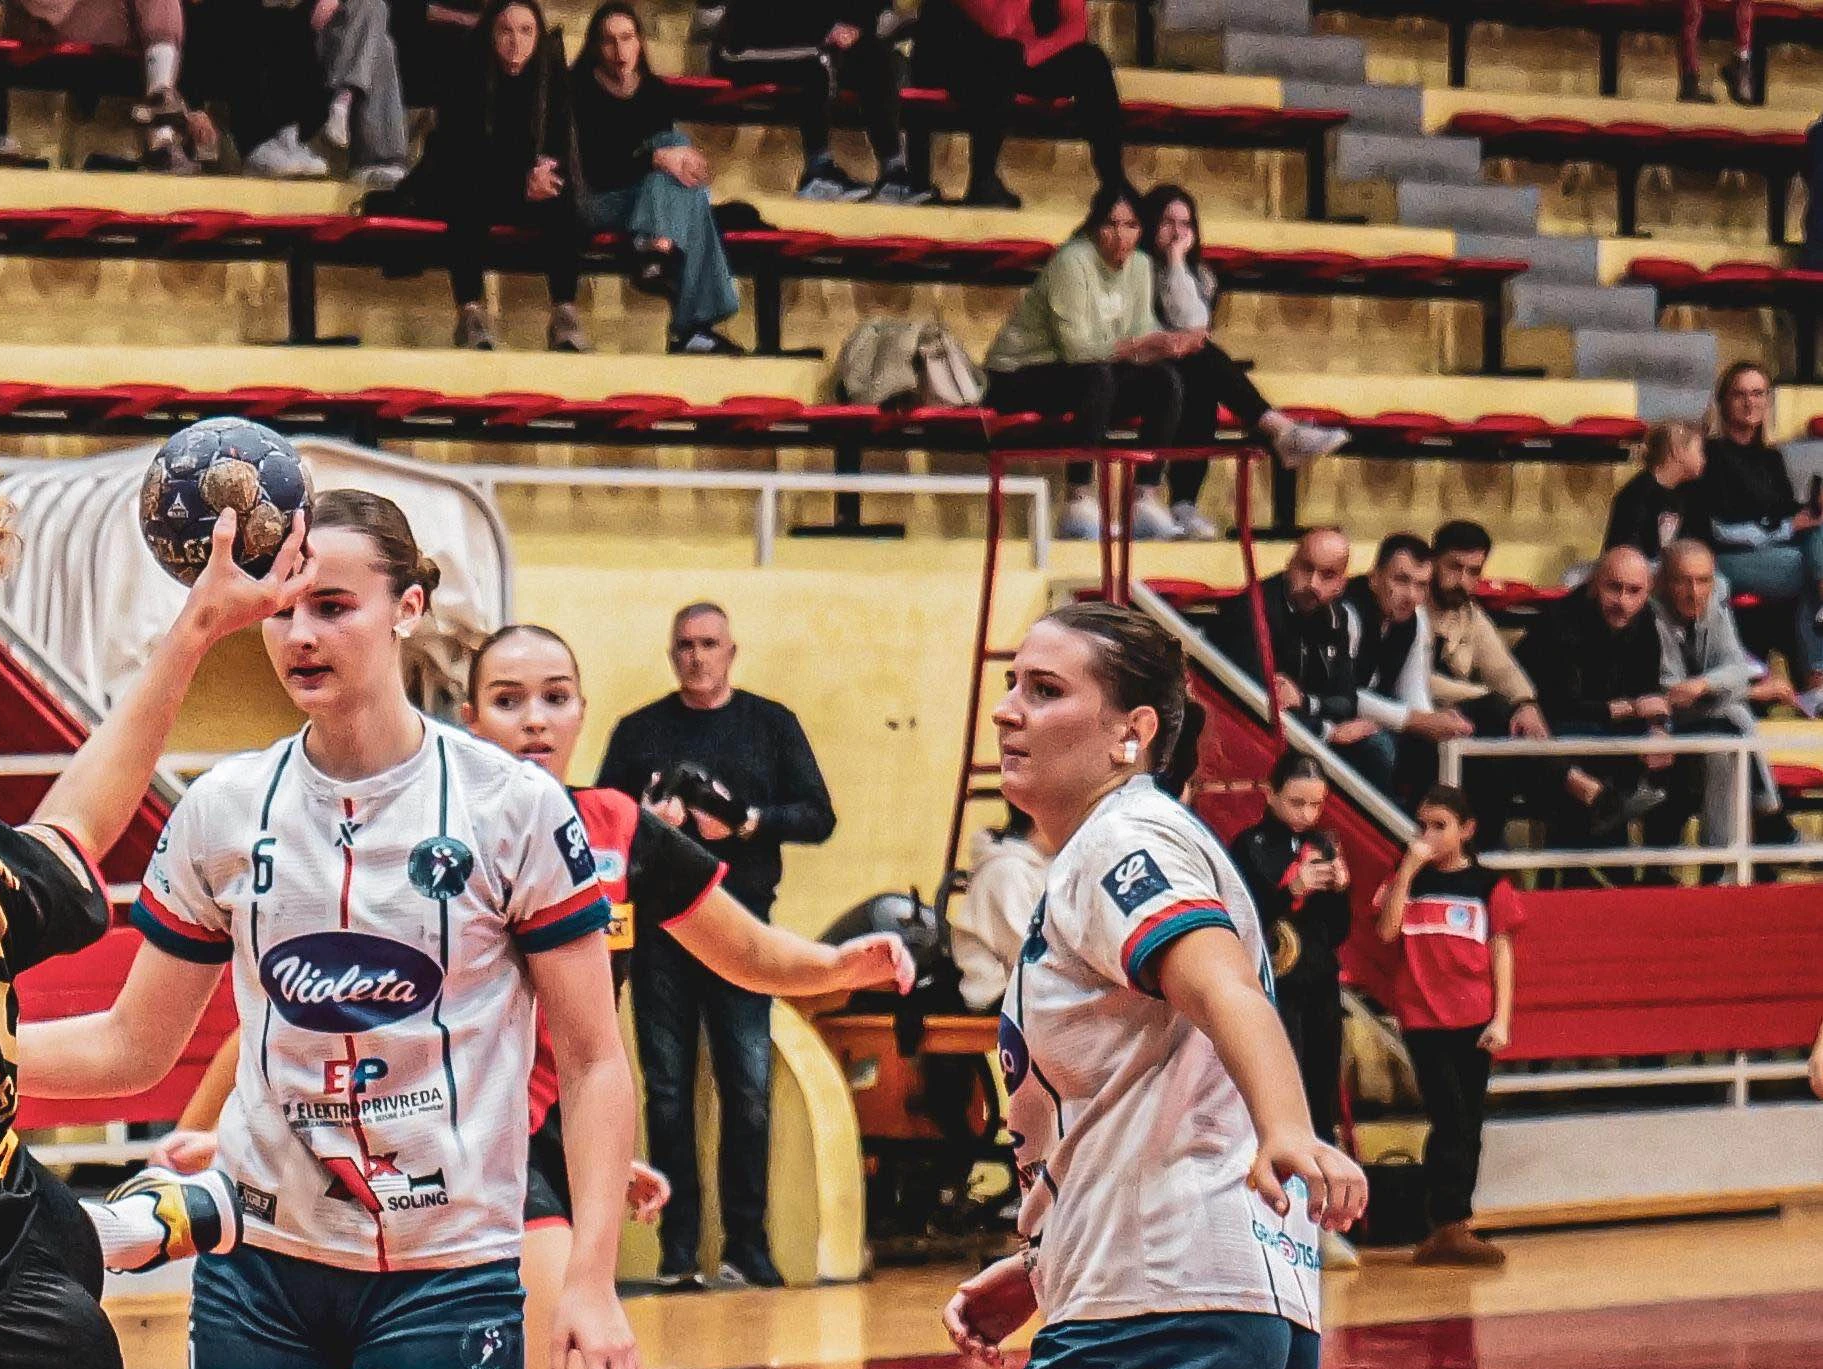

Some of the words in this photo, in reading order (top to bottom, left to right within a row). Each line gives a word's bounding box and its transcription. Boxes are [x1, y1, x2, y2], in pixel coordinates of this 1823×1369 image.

[252, 838, 276, 894] 6
[273, 955, 418, 1004] Violeta
[323, 1057, 389, 1095] EP
[387, 1191, 449, 1212] SOLING
